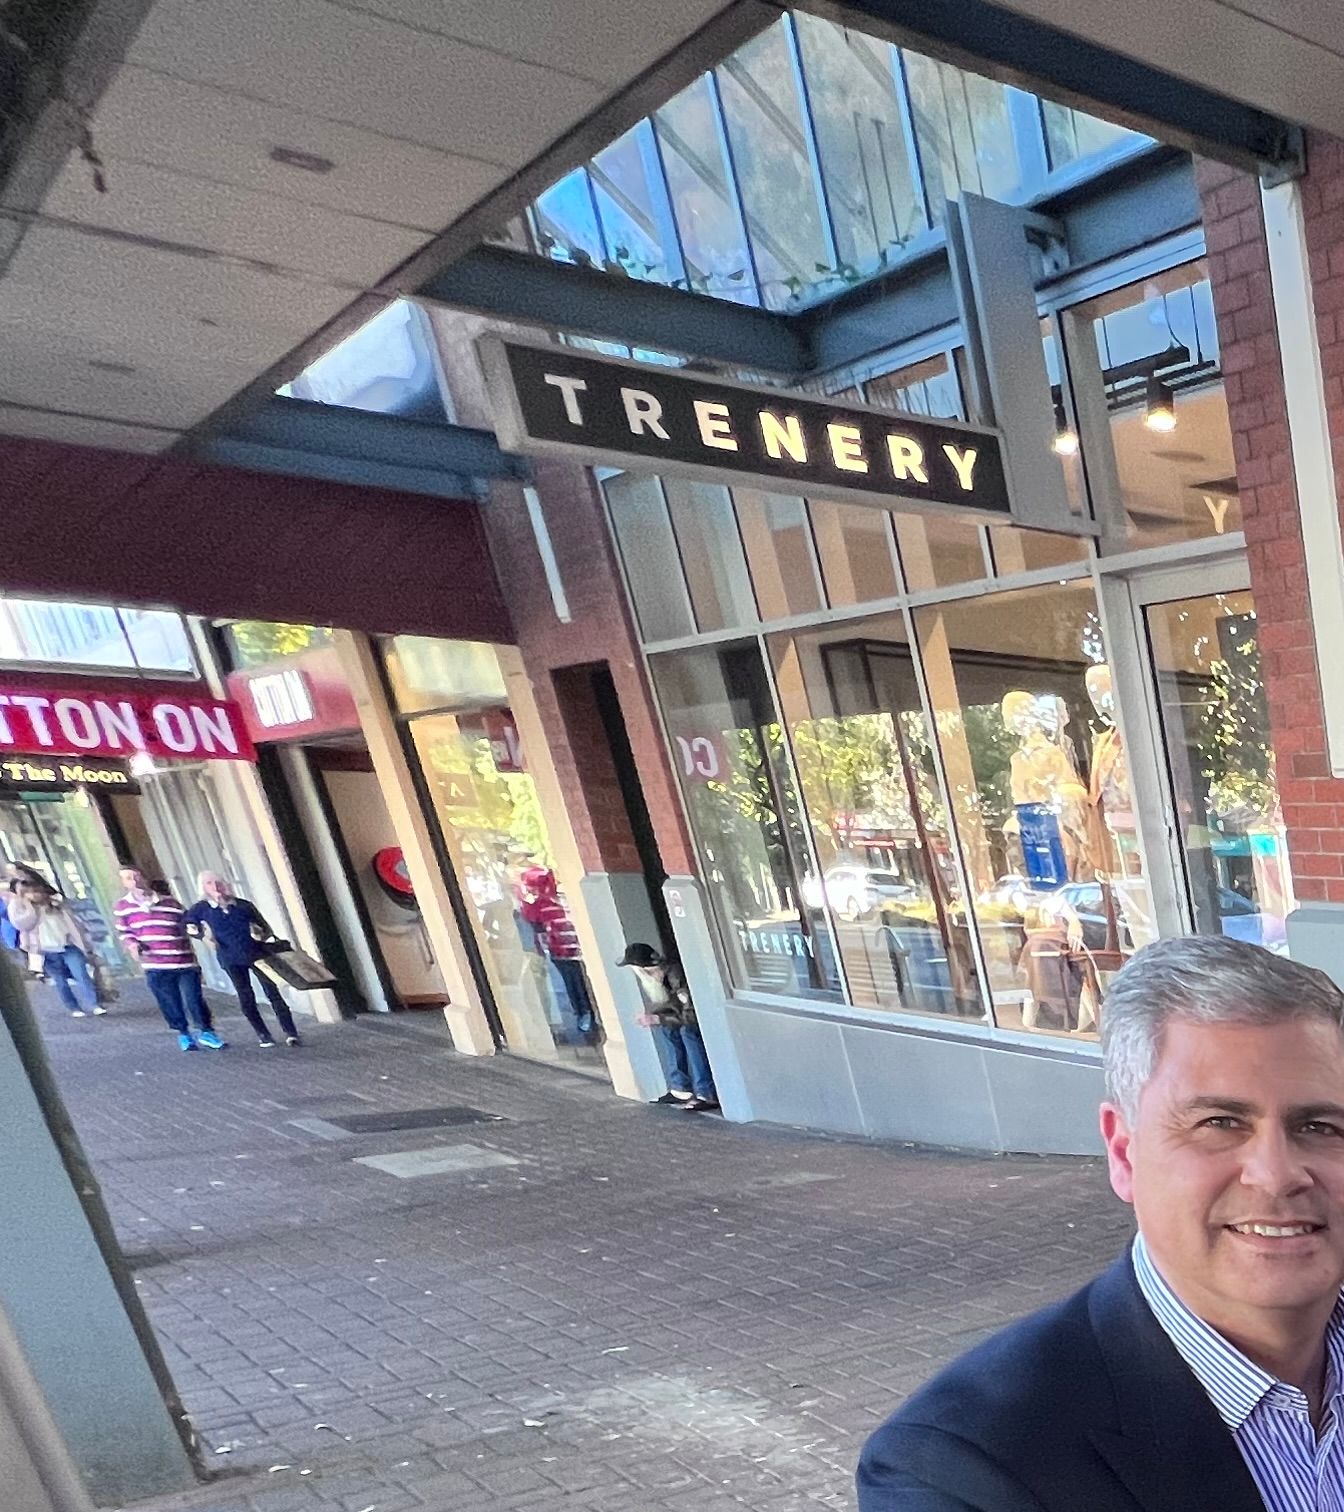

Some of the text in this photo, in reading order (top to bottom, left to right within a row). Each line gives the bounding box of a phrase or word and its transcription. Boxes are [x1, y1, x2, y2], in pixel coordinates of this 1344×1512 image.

[544, 373, 977, 492] TRENERY
[152, 703, 239, 754] ON
[2, 762, 57, 784] The
[61, 764, 128, 784] Moon
[738, 930, 815, 958] TRENERY
